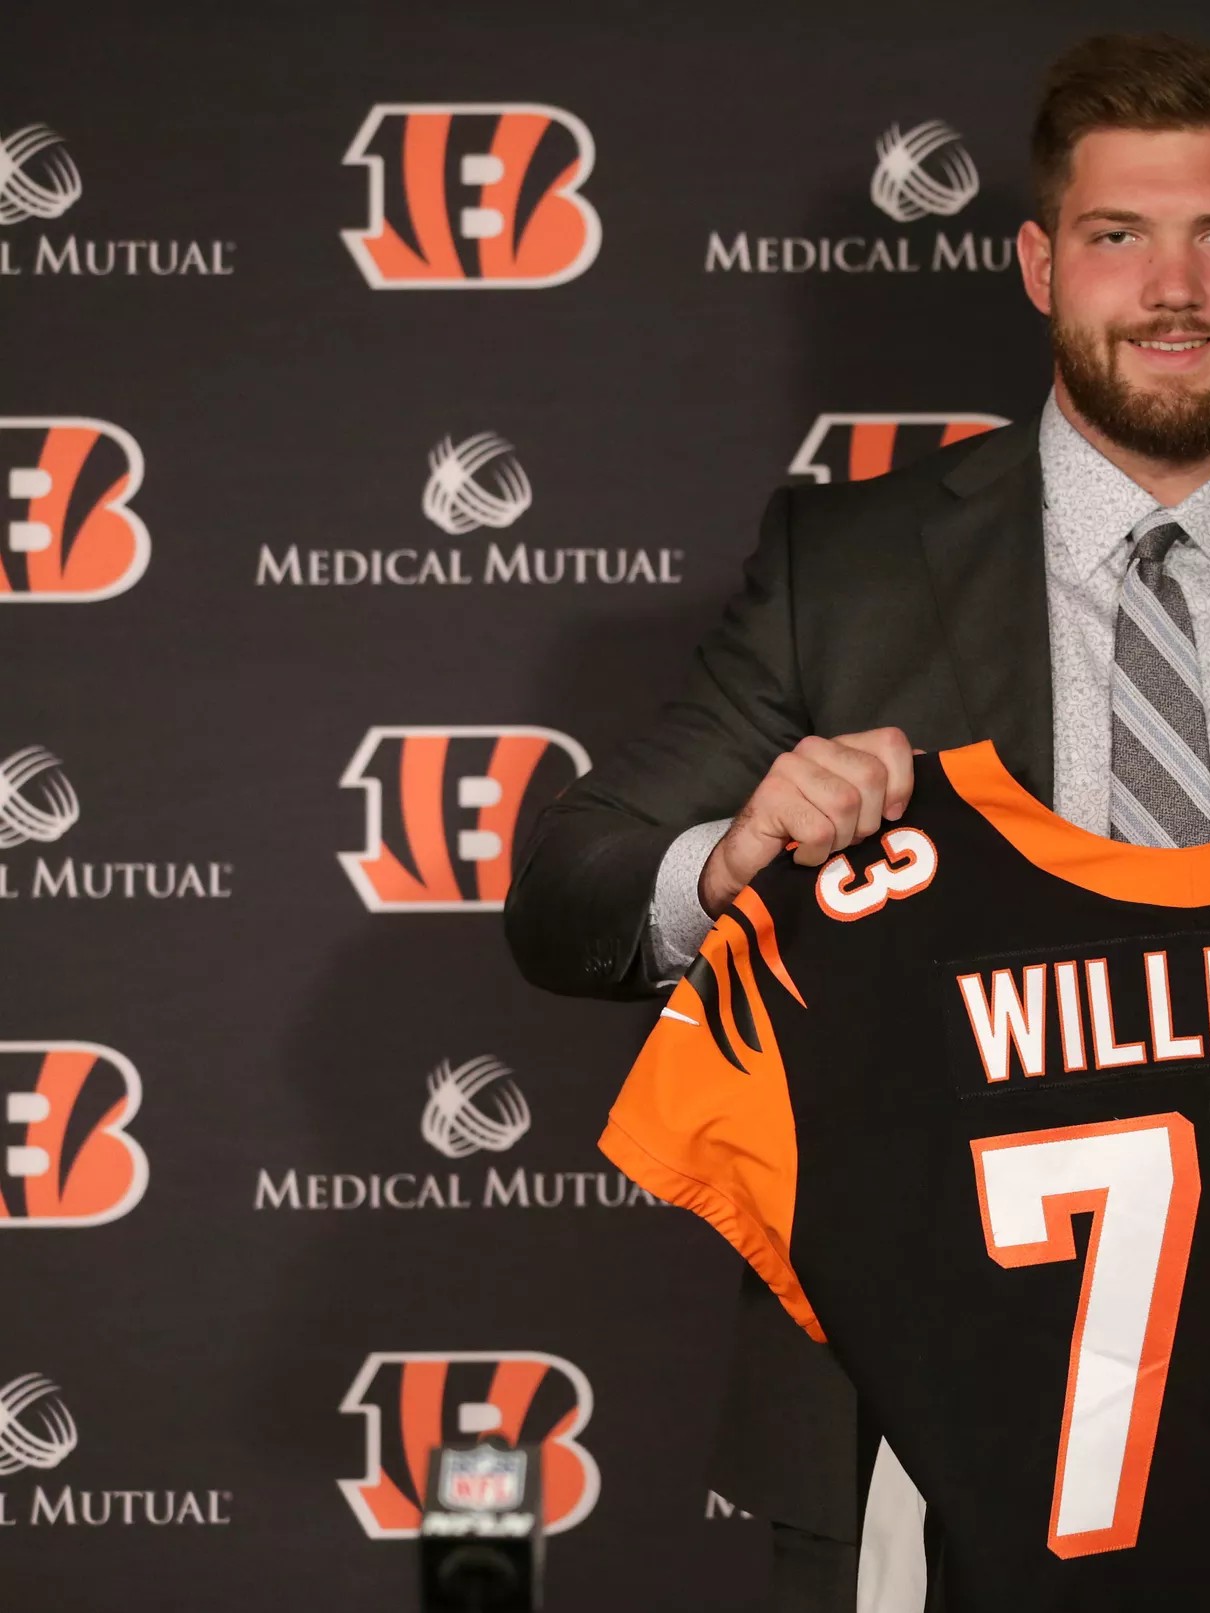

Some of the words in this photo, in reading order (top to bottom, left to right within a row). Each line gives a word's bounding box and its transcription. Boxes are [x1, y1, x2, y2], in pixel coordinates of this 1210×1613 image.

[36, 235, 235, 275] MUTUAL
[705, 231, 920, 272] MEDICAL
[256, 545, 471, 586] MEDICAL
[484, 544, 681, 584] MUTUAL
[33, 858, 232, 898] MUTUAL
[815, 827, 938, 922] 3
[255, 1169, 470, 1209] MEDICAL
[483, 1168, 672, 1208] MUTUA
[30, 1485, 231, 1526] MUTUAL
